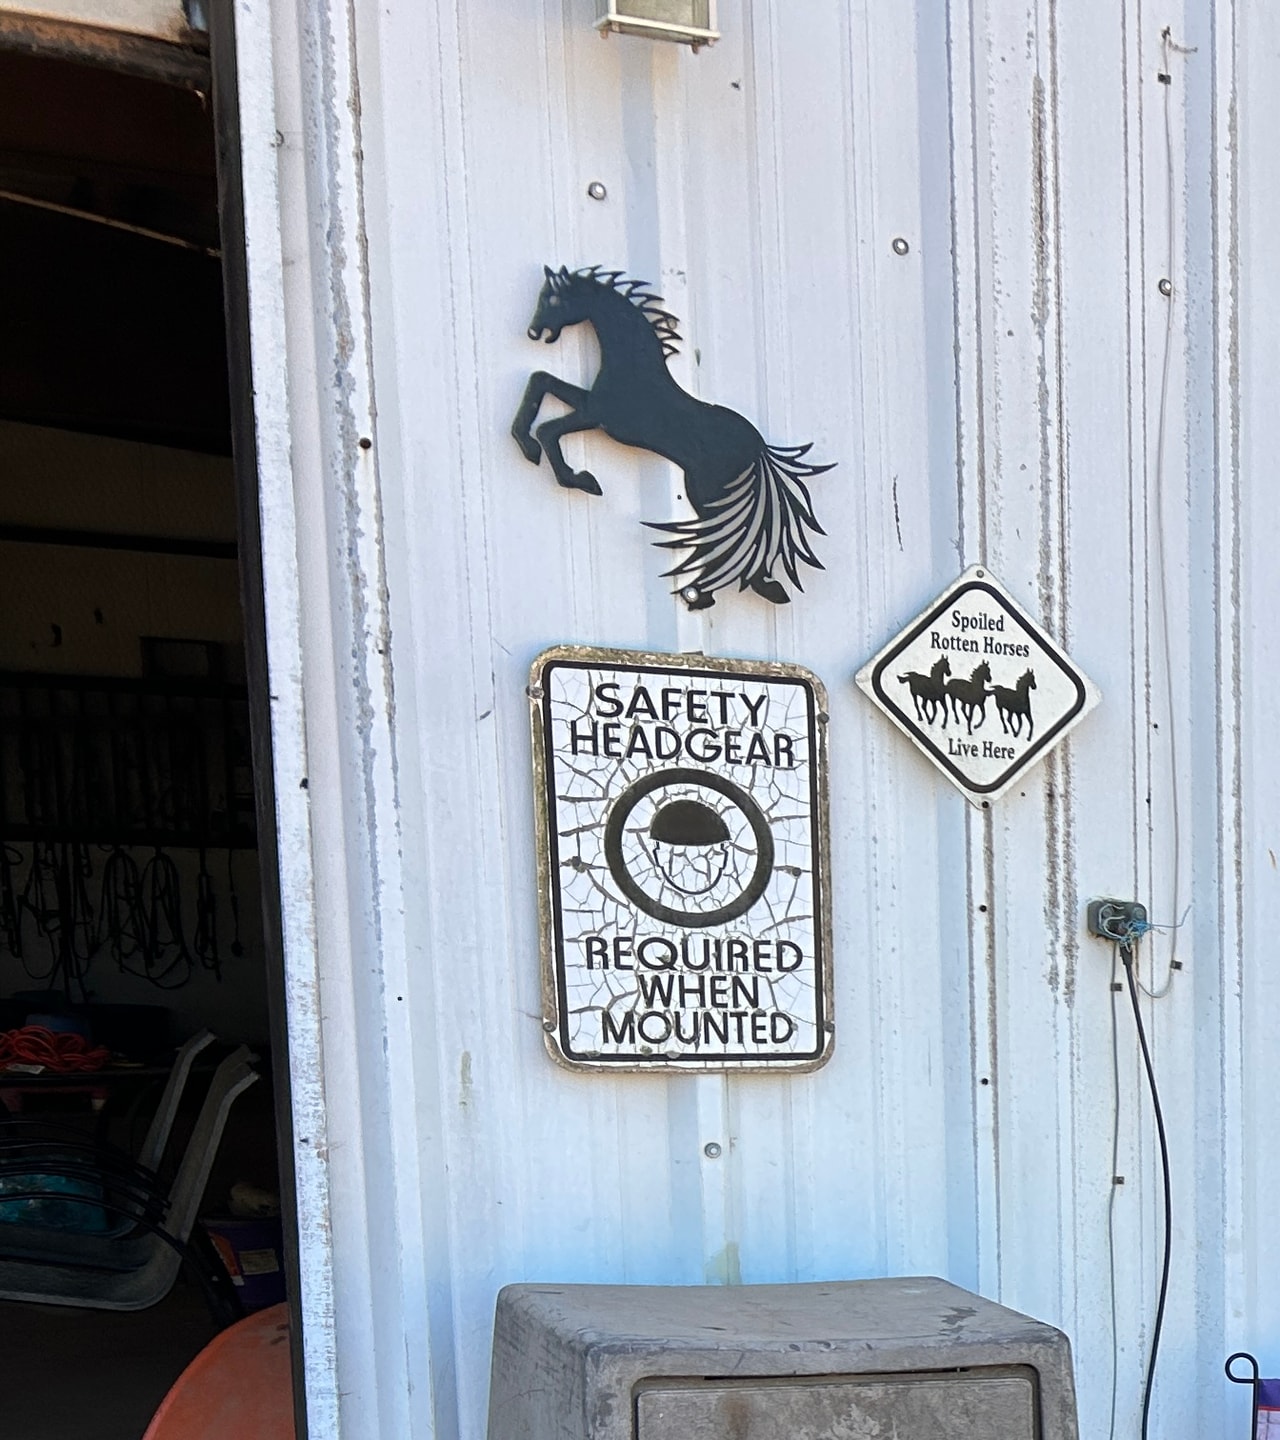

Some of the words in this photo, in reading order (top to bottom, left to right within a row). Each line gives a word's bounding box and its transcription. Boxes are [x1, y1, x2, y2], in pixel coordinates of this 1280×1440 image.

[952, 611, 1004, 632] Spoiled
[931, 632, 979, 652] Rotten
[984, 637, 1029, 657] Horses
[595, 683, 767, 727] SAFETY
[570, 721, 795, 767] HEADGEAR
[949, 739, 978, 757] Live
[984, 742, 1015, 759] Here
[586, 936, 803, 973] REQUIRED
[640, 975, 759, 1009] WHEN
[601, 1010, 795, 1045] MOUNTED
